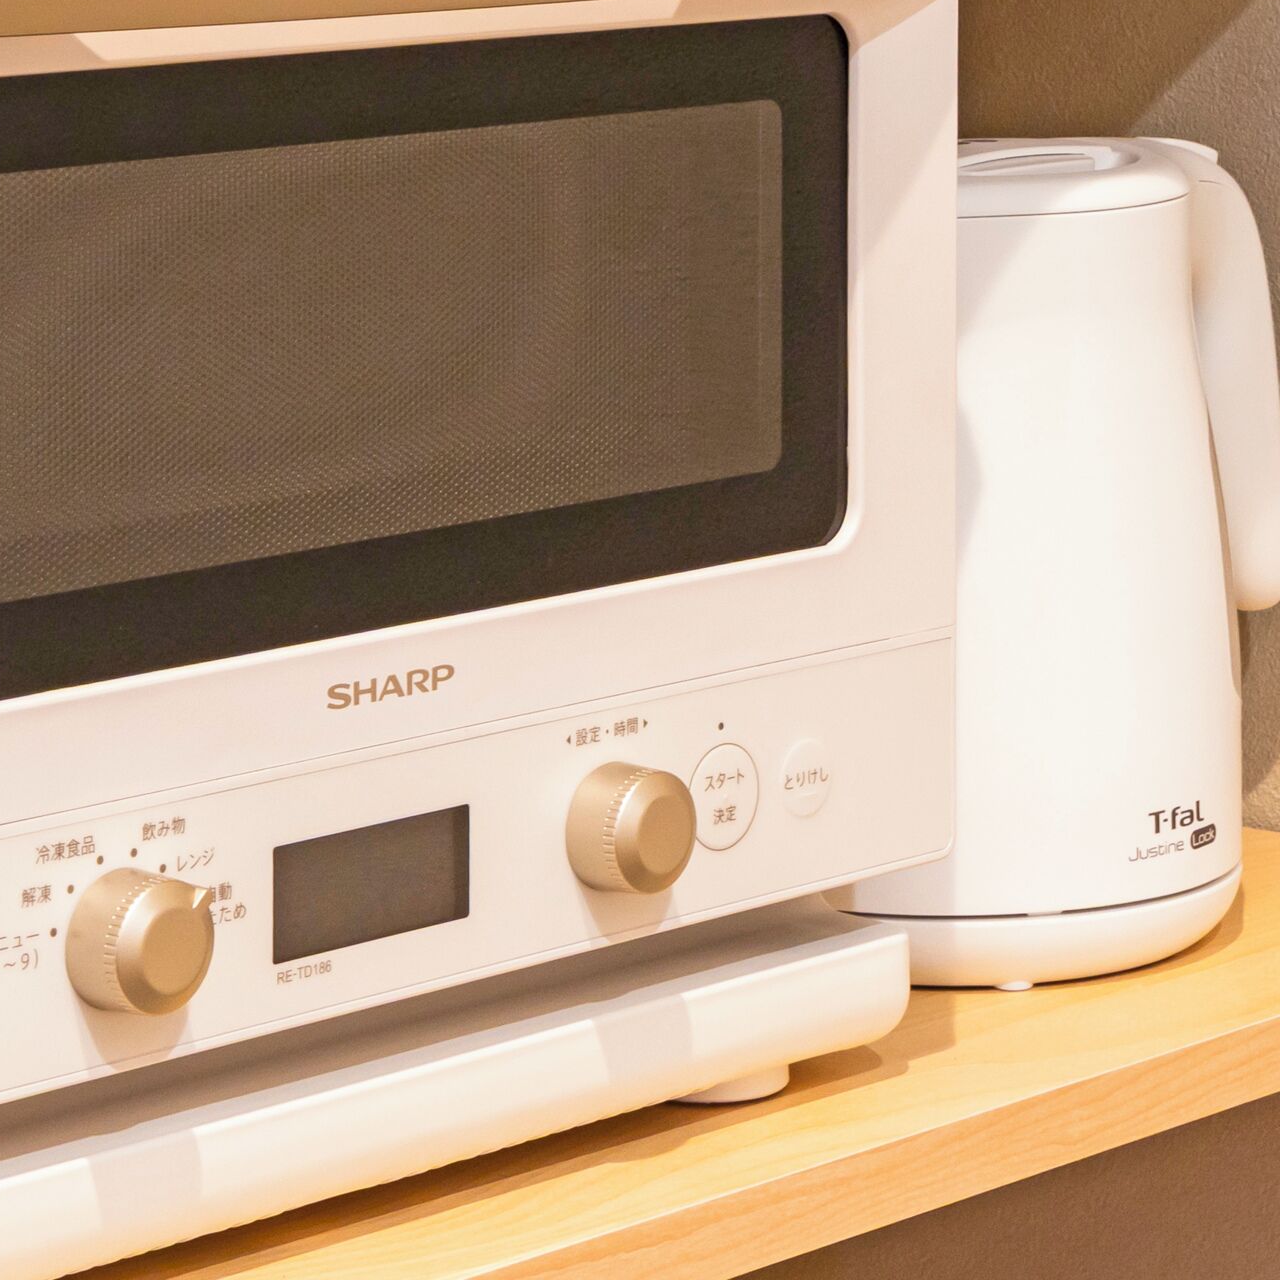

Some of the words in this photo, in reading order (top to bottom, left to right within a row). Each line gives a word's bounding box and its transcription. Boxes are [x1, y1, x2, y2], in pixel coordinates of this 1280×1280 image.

[327, 664, 455, 710] SHARP
[575, 717, 639, 747] 設定・時間
[704, 768, 745, 792] スタート
[783, 767, 830, 791] とりけし
[713, 805, 737, 826] 決定
[1148, 800, 1205, 834] T-fal
[142, 816, 186, 841] 飲み物
[35, 835, 96, 865] 冷凍食品
[1128, 840, 1185, 862] Justine
[1192, 825, 1216, 848] Lock
[176, 847, 215, 872] レンジ
[21, 885, 52, 908] 解凍
[276, 959, 332, 985] RE-TD186
